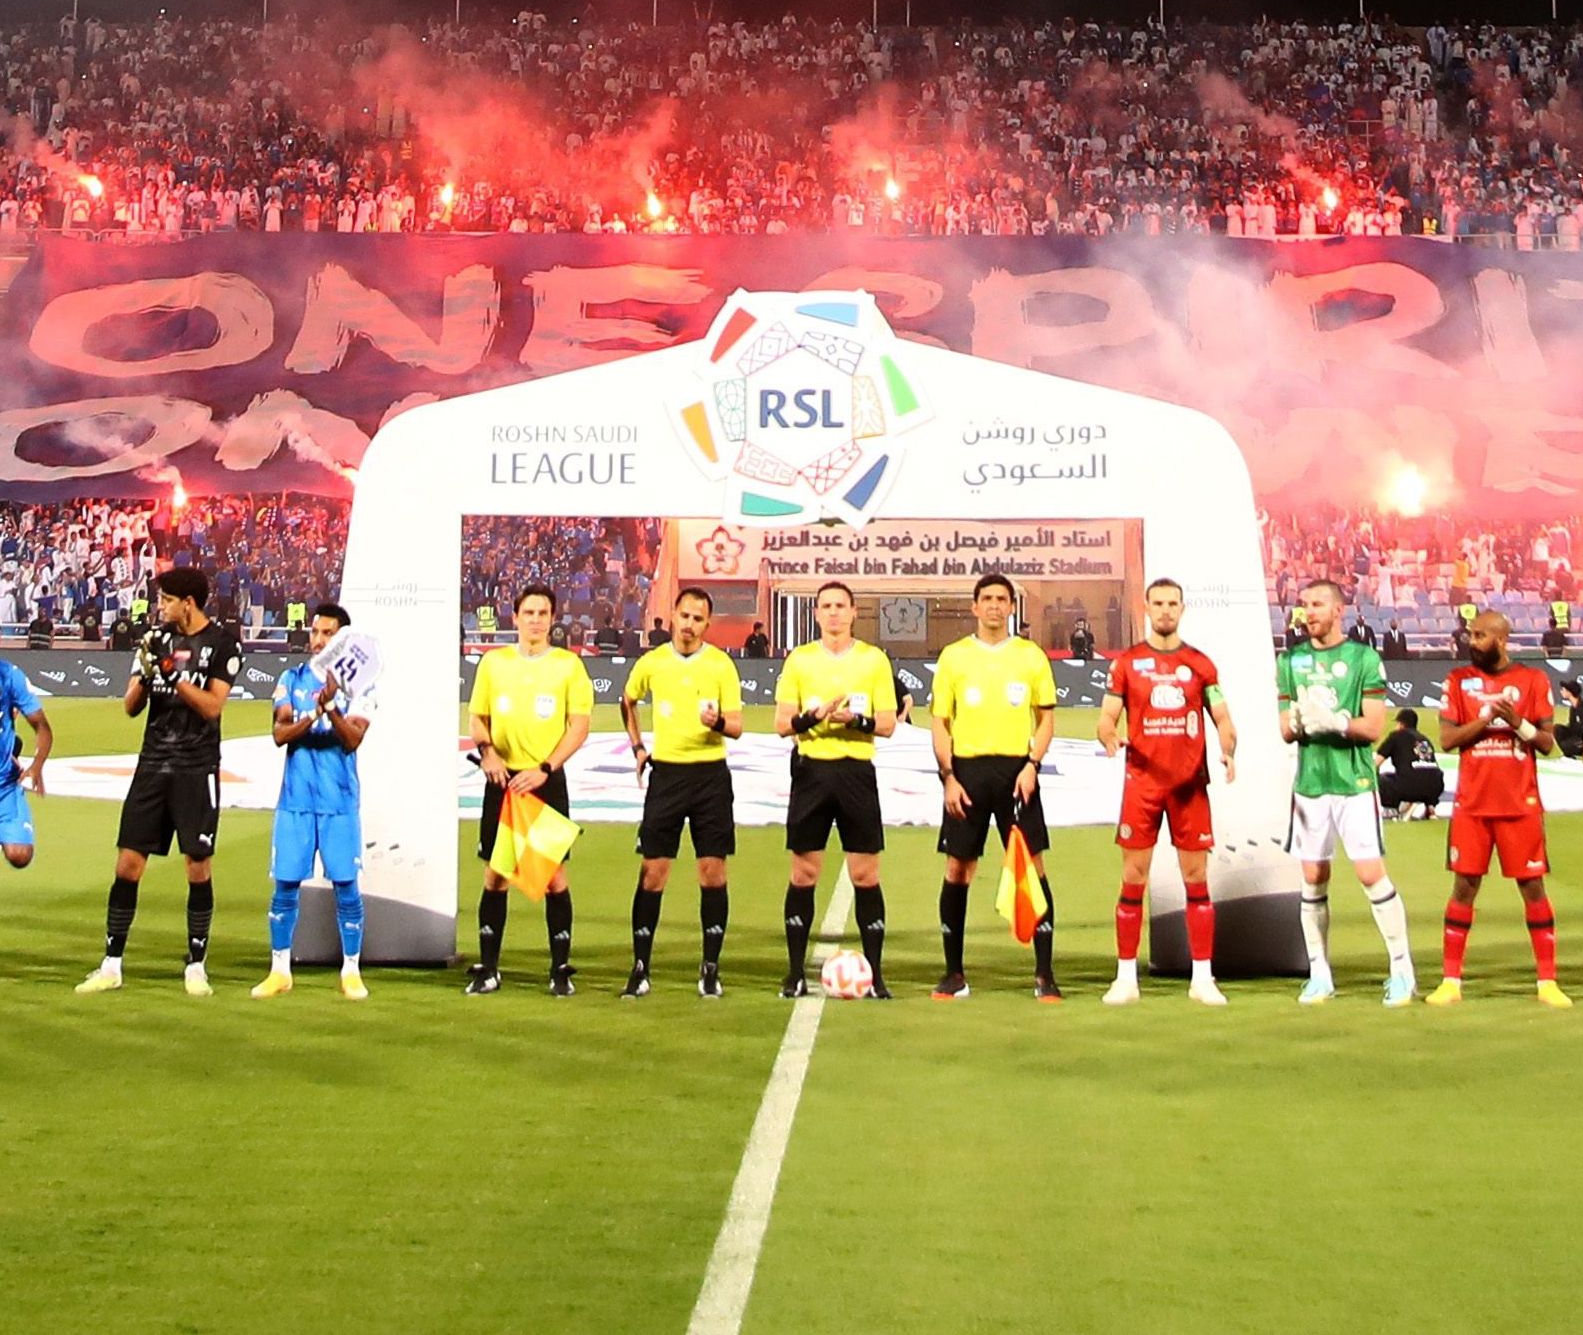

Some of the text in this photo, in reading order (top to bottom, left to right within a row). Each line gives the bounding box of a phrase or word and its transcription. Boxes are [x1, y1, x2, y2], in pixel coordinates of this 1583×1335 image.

[29, 261, 714, 378] ONE
[759, 388, 844, 429] RSL
[491, 424, 637, 443] ROSHN SAUDI
[962, 416, 1107, 452] دوري روشن
[490, 452, 637, 484] LEAGUE
[963, 453, 1107, 494] السعودي
[875, 530, 914, 552] فهد
[919, 533, 941, 553] بن
[946, 530, 1000, 552] فيصل
[814, 556, 859, 575] Faisal
[863, 556, 887, 575] bin
[892, 556, 938, 575] Fahad
[942, 556, 966, 575] bin
[970, 556, 1045, 575] Abdulaziz
[1049, 556, 1113, 575] Stadium
